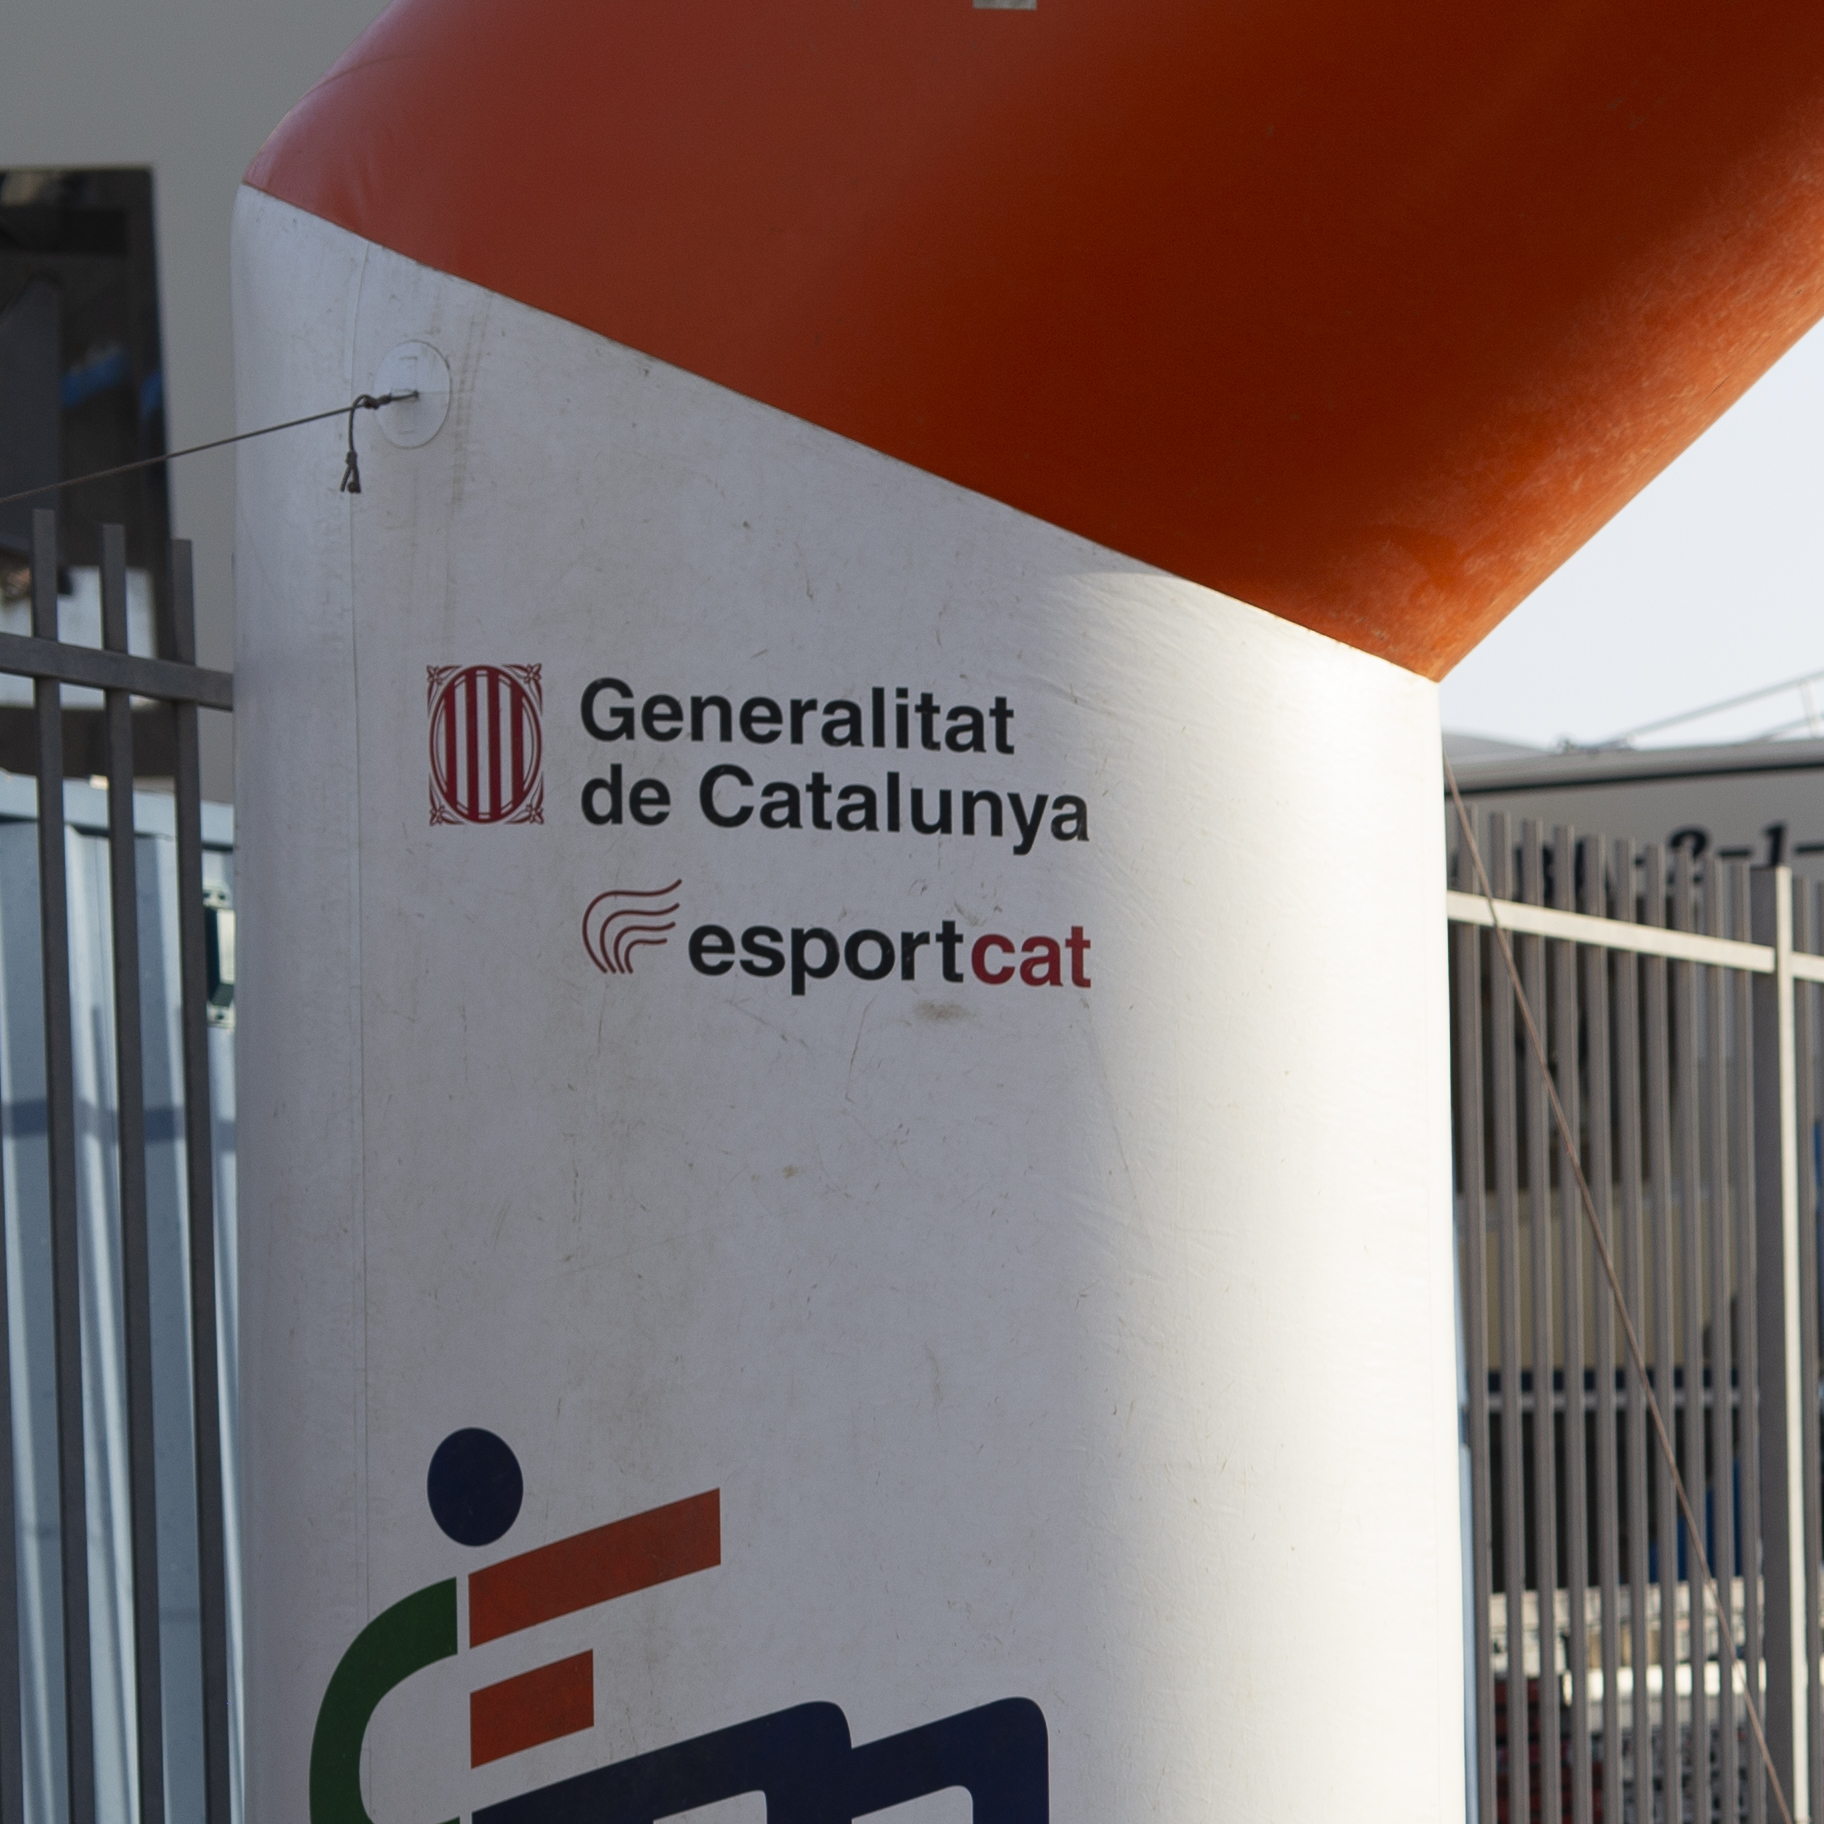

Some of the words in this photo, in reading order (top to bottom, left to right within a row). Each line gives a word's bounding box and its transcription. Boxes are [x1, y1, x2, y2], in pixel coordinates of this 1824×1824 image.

[580, 678, 1015, 756] Generalitat
[580, 765, 671, 826] de
[699, 764, 1089, 855] Catalunya
[688, 919, 1091, 996] esportcat
